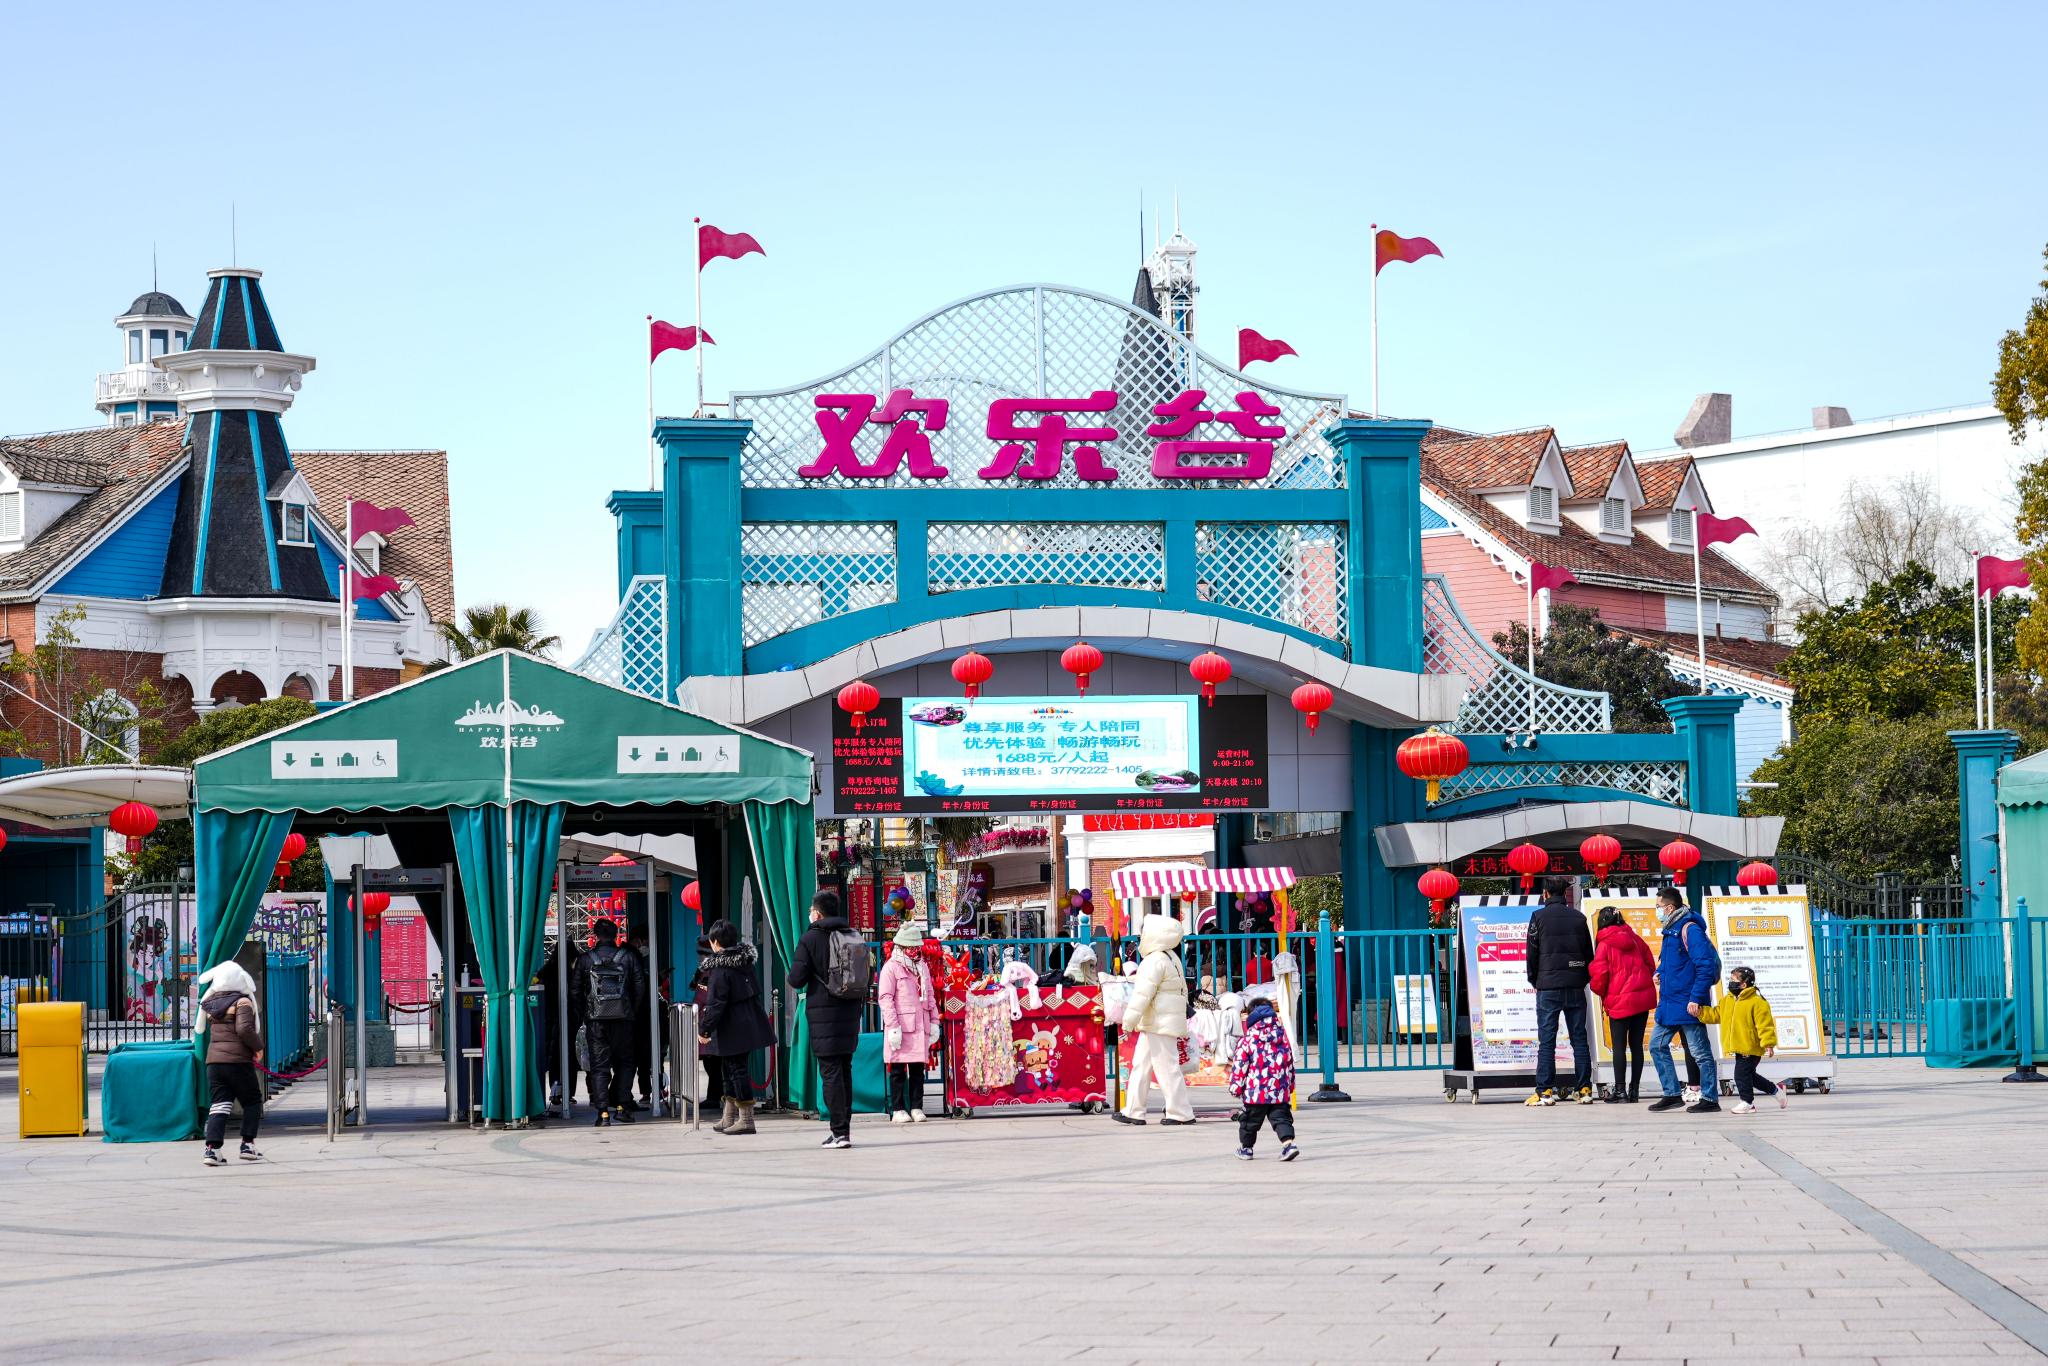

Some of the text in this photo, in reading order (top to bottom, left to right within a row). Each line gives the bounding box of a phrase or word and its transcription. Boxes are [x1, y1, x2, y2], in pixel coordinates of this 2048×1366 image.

[798, 390, 1286, 480] 欢乐谷
[963, 720, 1140, 734] 尊享服务 专人陪同
[479, 736, 538, 749] 欢乐谷
[963, 735, 1141, 749] 优先体验 畅游畅玩
[996, 750, 1109, 763] 1688元/人起
[1217, 750, 1249, 759] 运营时间
[845, 758, 893, 766] 1688元/人起
[847, 777, 899, 786] 尊享咨询电话
[1241, 778, 1262, 786] 20:10
[840, 787, 897, 795] 37792222-1405
[854, 802, 902, 811] 年卡/身份证
[942, 801, 989, 810] 年卡/身份证
[1029, 800, 1077, 809] 年卡/身份证
[1116, 799, 1163, 808] 年卡/身份证
[1202, 798, 1249, 807] 年卡/身份证
